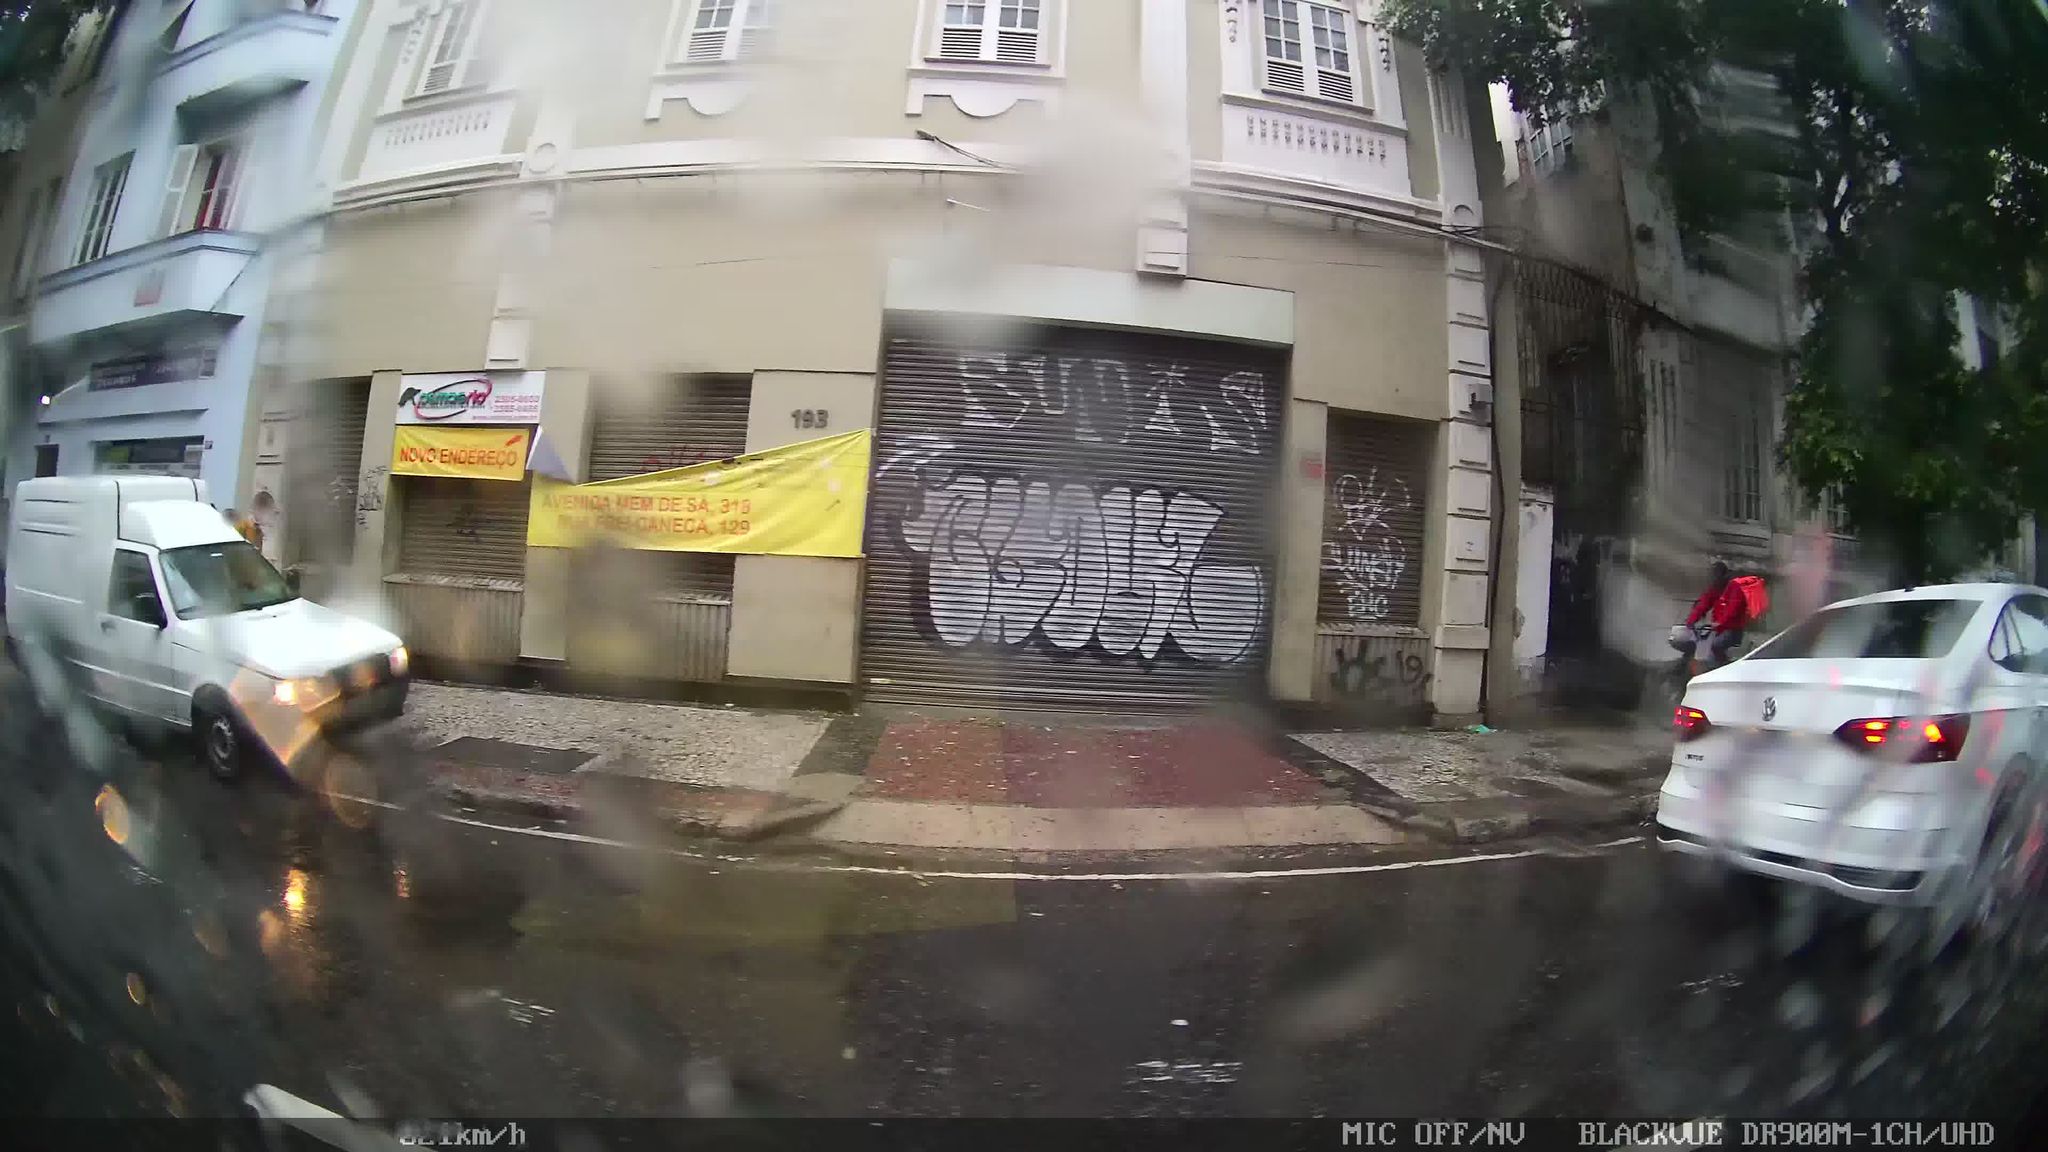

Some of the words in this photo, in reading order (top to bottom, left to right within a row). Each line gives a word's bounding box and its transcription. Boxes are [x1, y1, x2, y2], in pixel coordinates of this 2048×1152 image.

[791, 409, 829, 429] 193
[400, 448, 436, 463] NOVO
[439, 448, 519, 467] ENDEREÇO
[659, 497, 683, 512] DE
